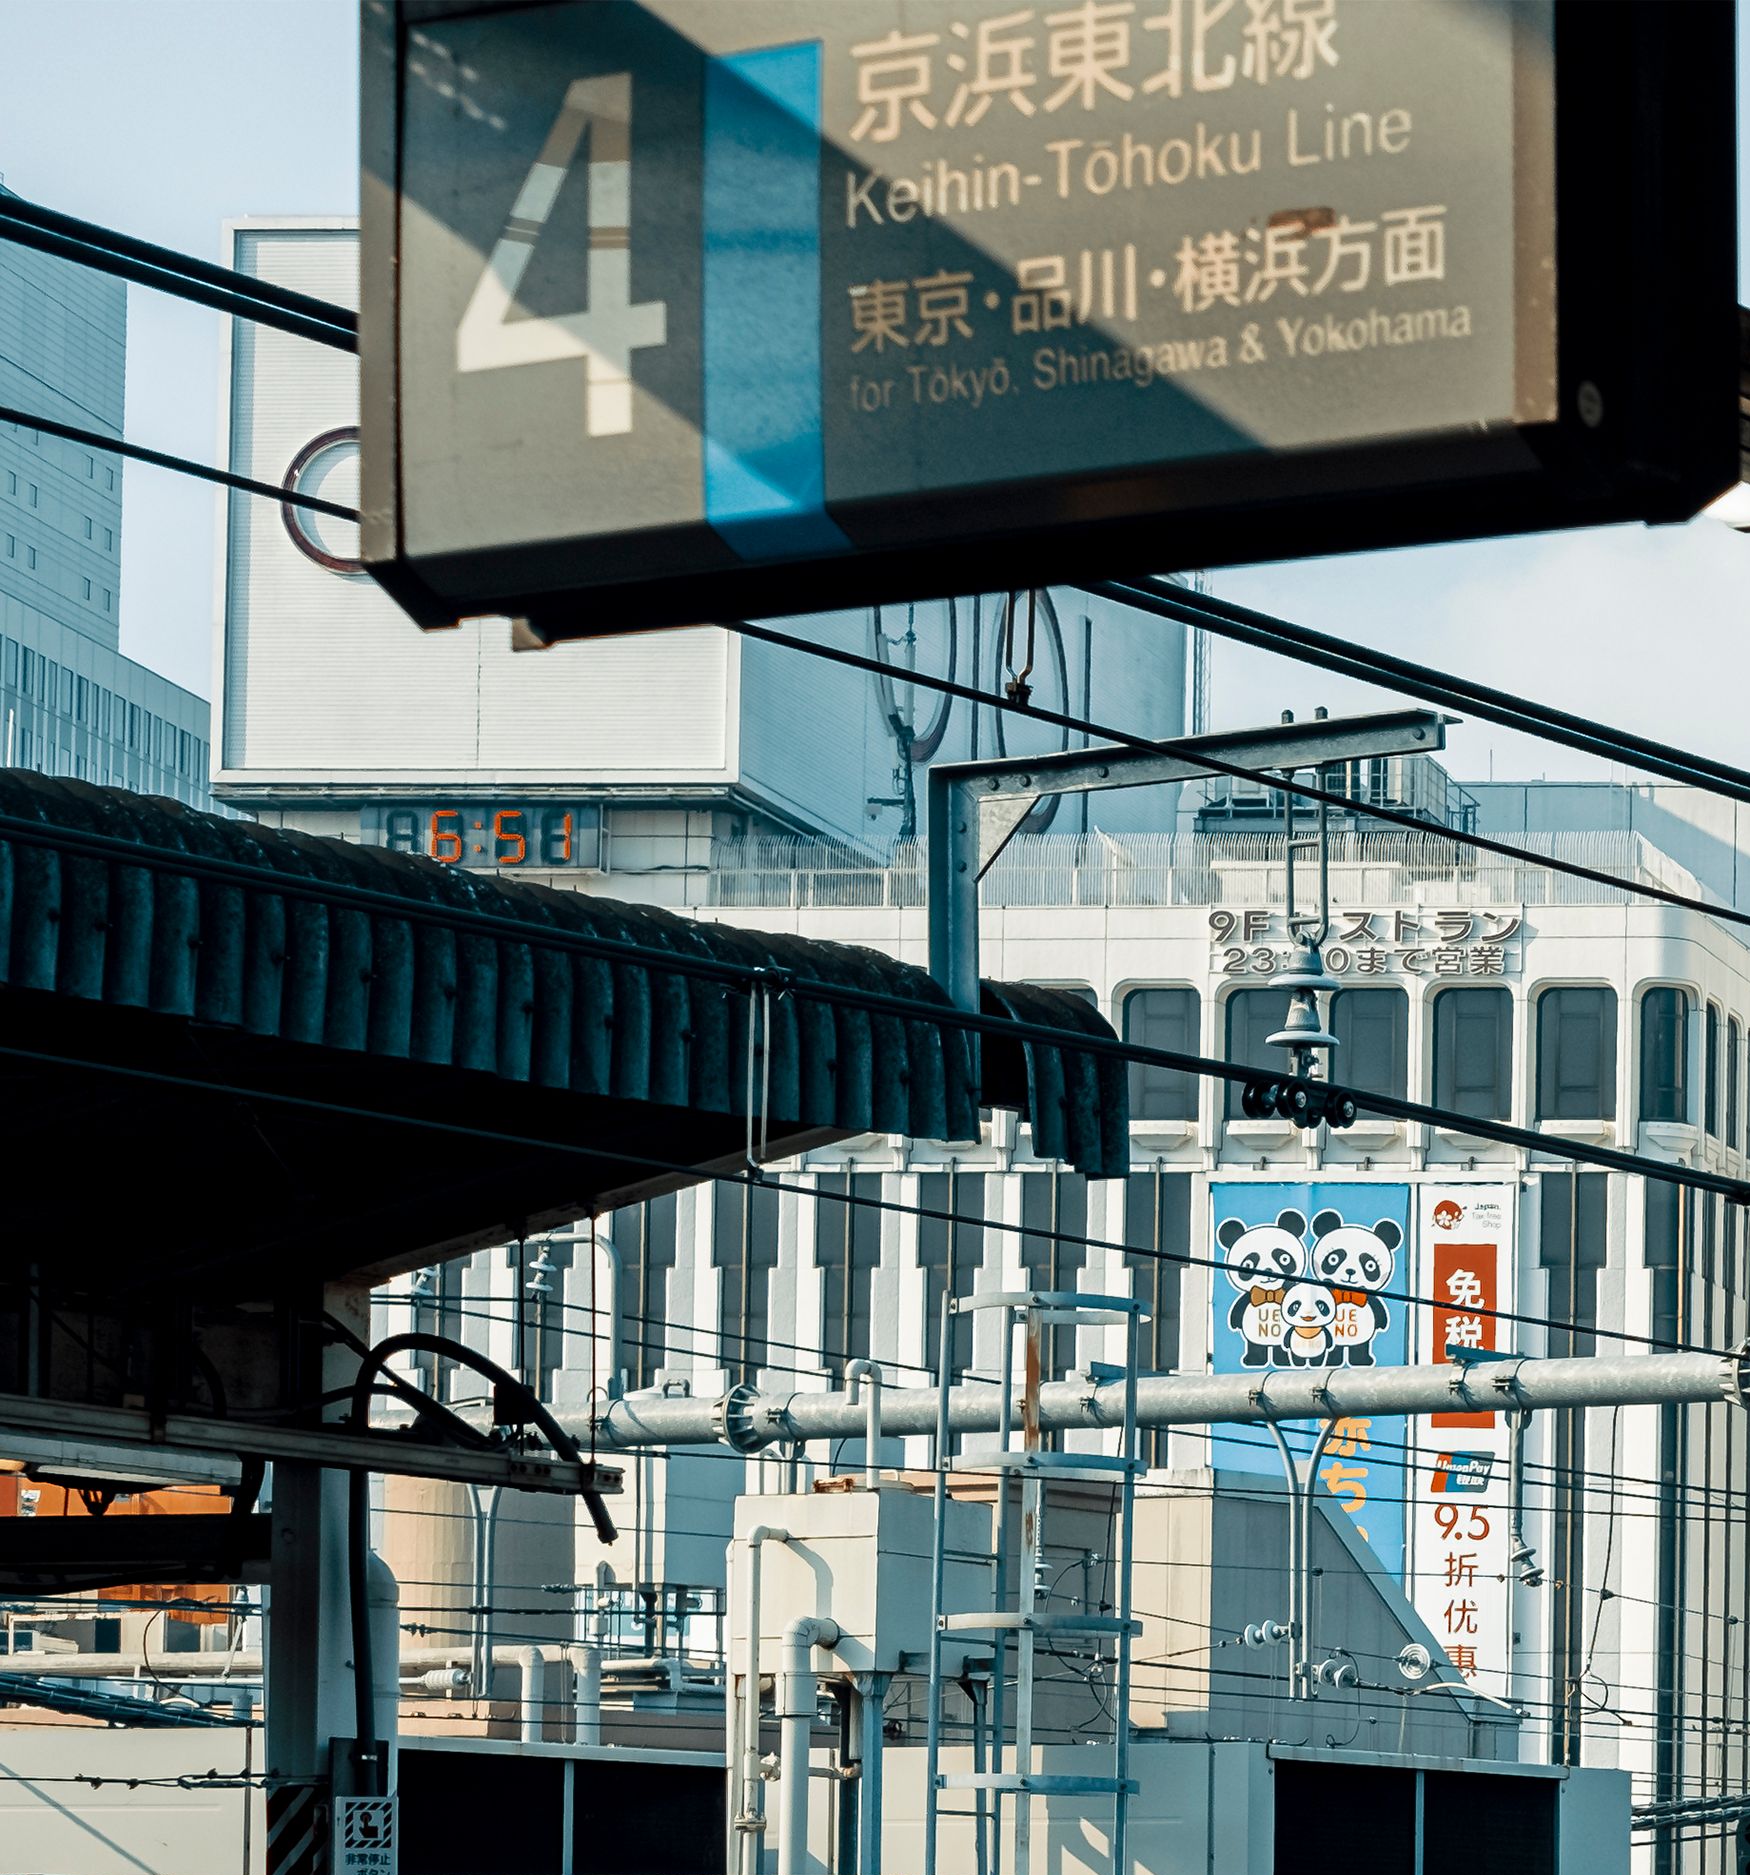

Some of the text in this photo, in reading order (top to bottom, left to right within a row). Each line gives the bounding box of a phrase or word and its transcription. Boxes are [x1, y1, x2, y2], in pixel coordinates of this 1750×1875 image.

[849, 0, 1340, 142] 京浜東北線
[846, 103, 1412, 229] Keihin-Tōhoku Line
[456, 70, 668, 436] 4
[849, 205, 1448, 354] 東京・品川・横浜方面
[850, 376, 893, 412] for
[1034, 335, 1228, 390] Shinagawa
[1239, 322, 1266, 364] &
[1277, 304, 1472, 357] Yokohama
[431, 809, 572, 864] 6:51
[1208, 910, 1521, 944] 9F ストラン
[1222, 946, 1506, 976] 23:0まで営業
[1445, 1267, 1486, 1350] 免税
[1434, 1503, 1490, 1541] 9.5
[346, 1853, 391, 1866] 非常停止
